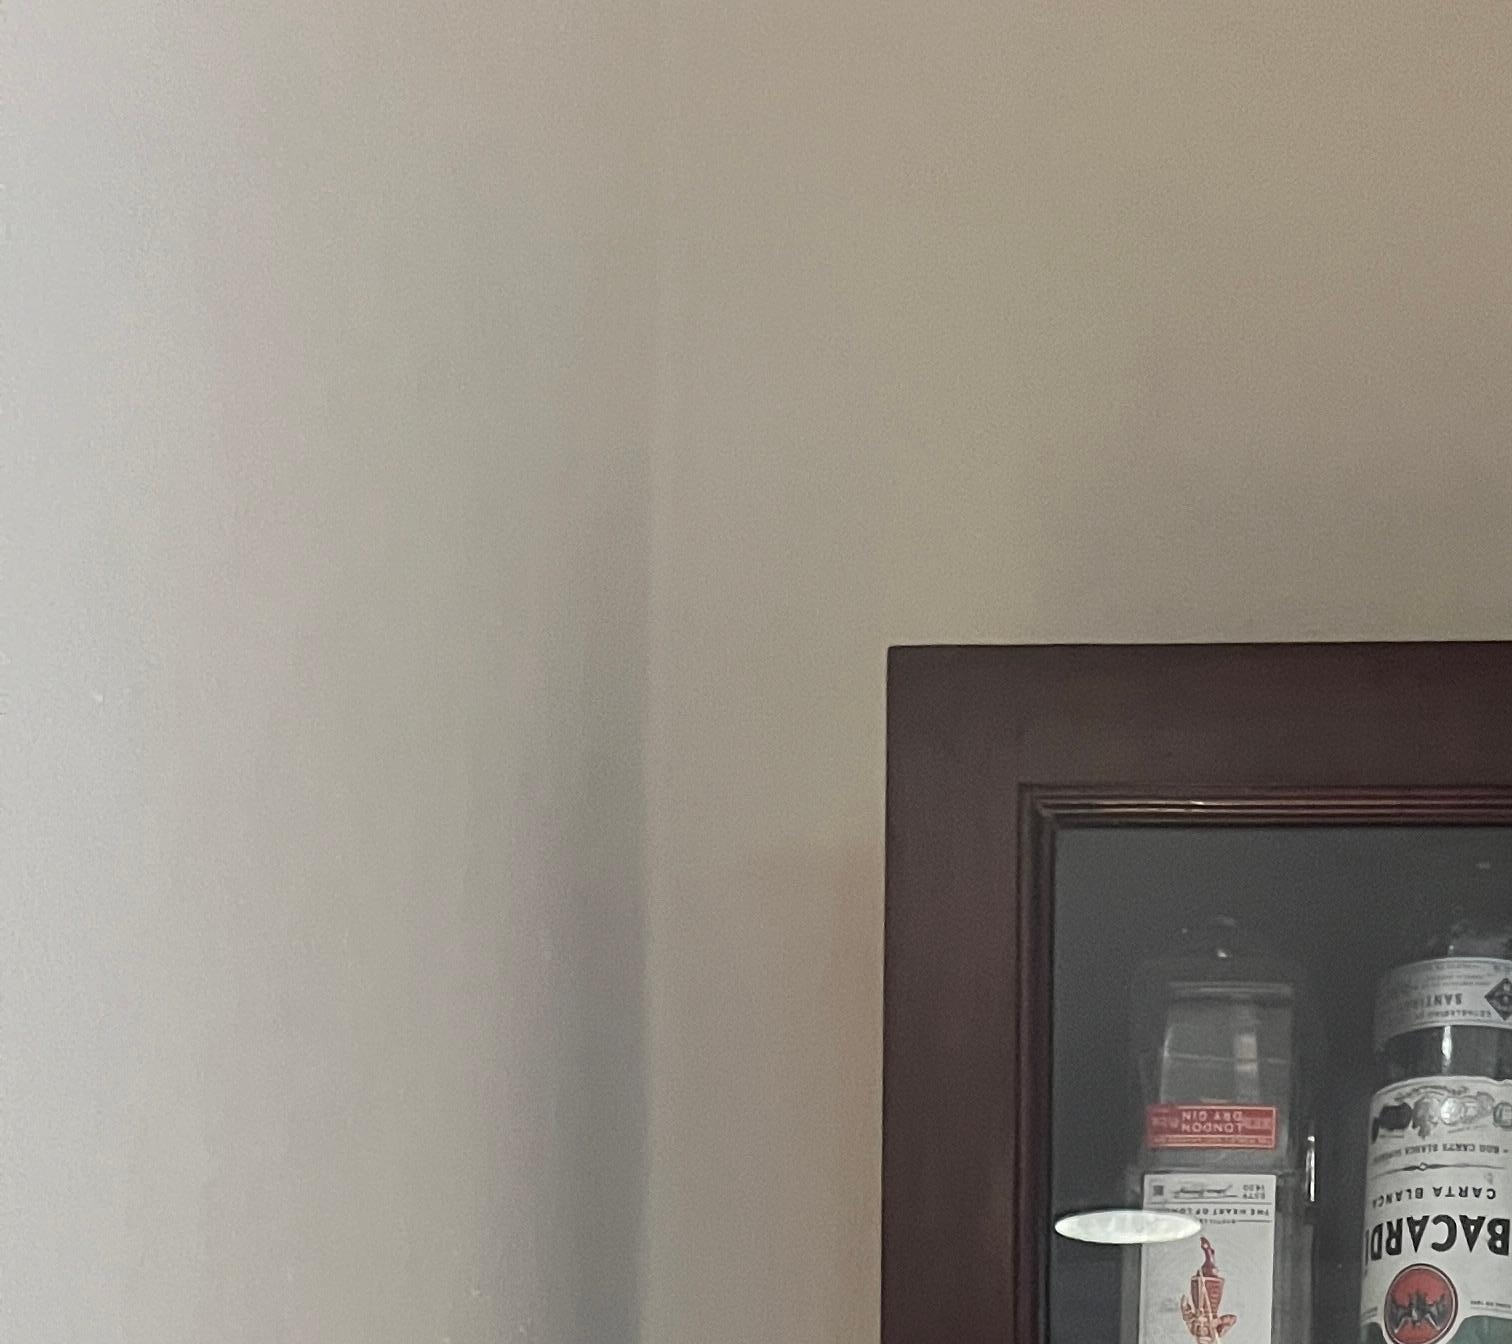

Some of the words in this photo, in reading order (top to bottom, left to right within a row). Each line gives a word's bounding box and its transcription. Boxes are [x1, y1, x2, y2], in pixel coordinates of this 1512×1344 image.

[1181, 1110, 1208, 1121] GIN
[1213, 1110, 1243, 1121] DRY
[1180, 1122, 1243, 1133] LONDON
[1371, 1187, 1424, 1208] BLANCA
[1432, 1185, 1497, 1200] CARTA
[1249, 1207, 1270, 1217] THE
